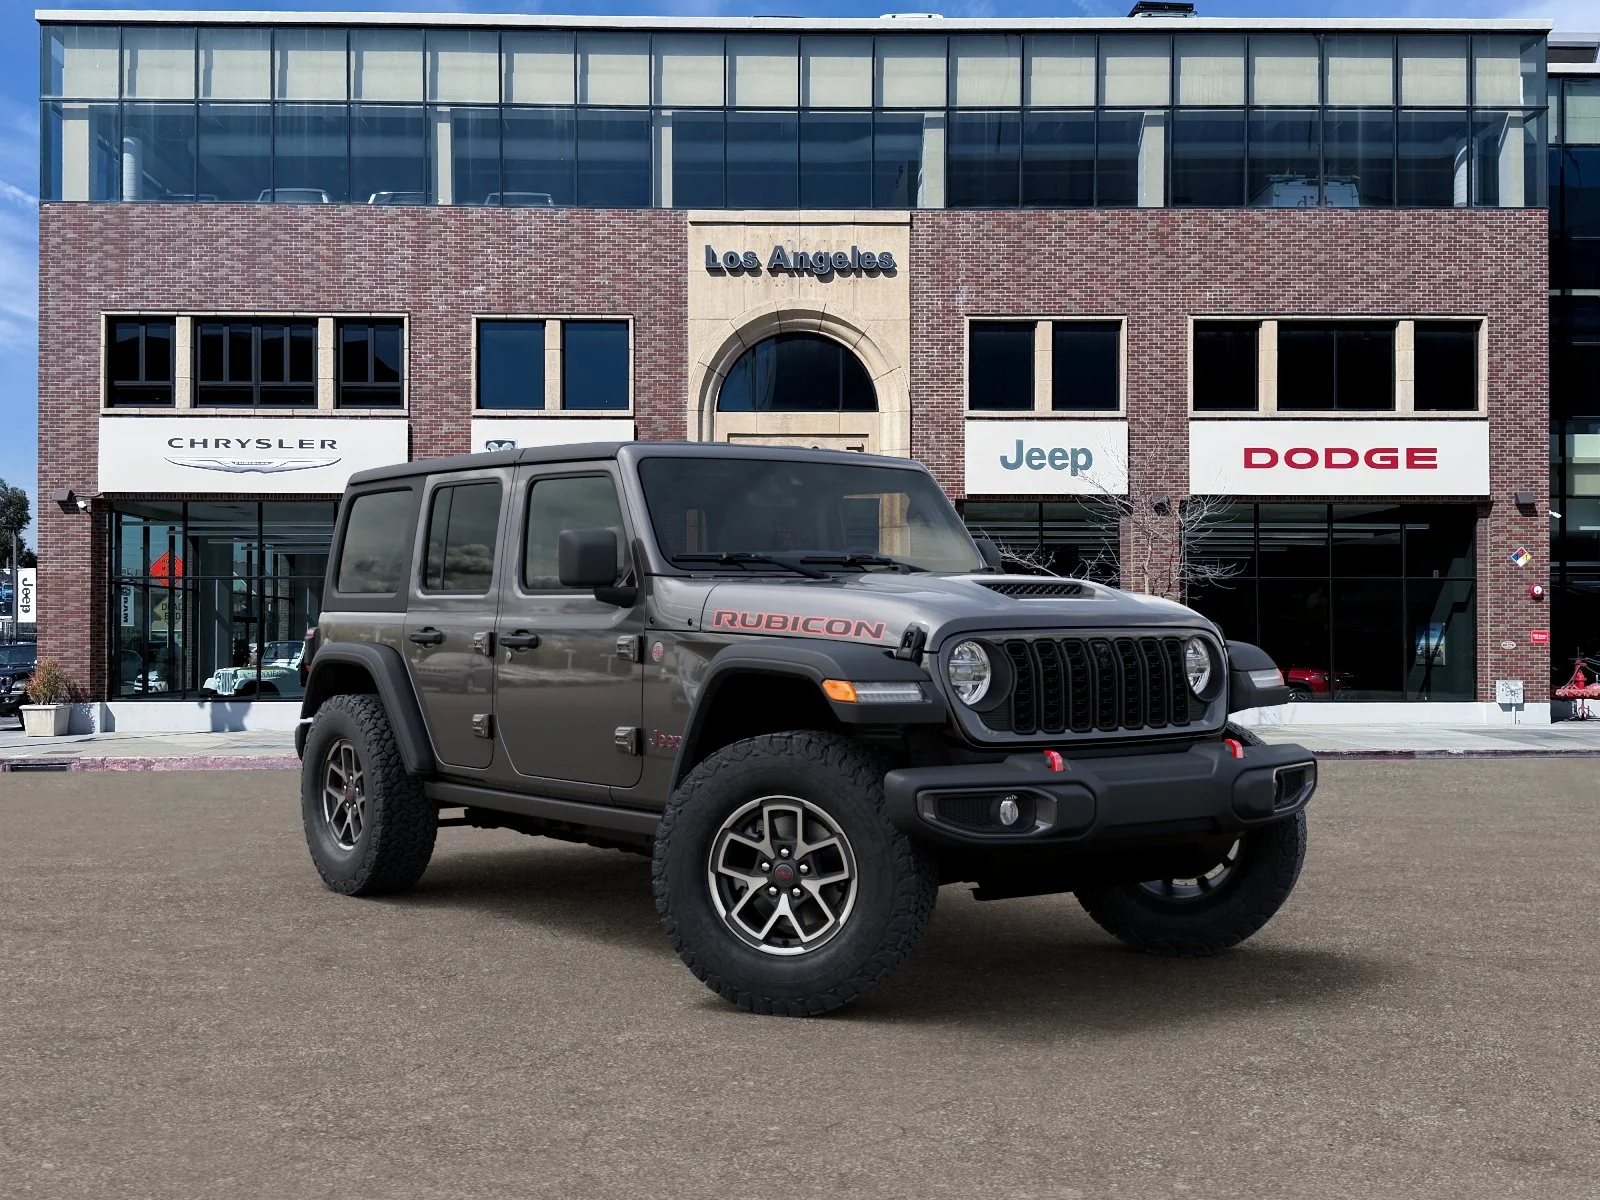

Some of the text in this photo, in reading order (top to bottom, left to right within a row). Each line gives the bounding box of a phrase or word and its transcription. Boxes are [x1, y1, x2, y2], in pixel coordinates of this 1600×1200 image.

[704, 244, 895, 275] Los Angeles
[167, 437, 338, 450] CHRYSLER
[999, 438, 1094, 477] Jeep
[1243, 447, 1438, 470] DODGE
[20, 577, 34, 614] Jeep
[713, 609, 887, 641] RUBICON
